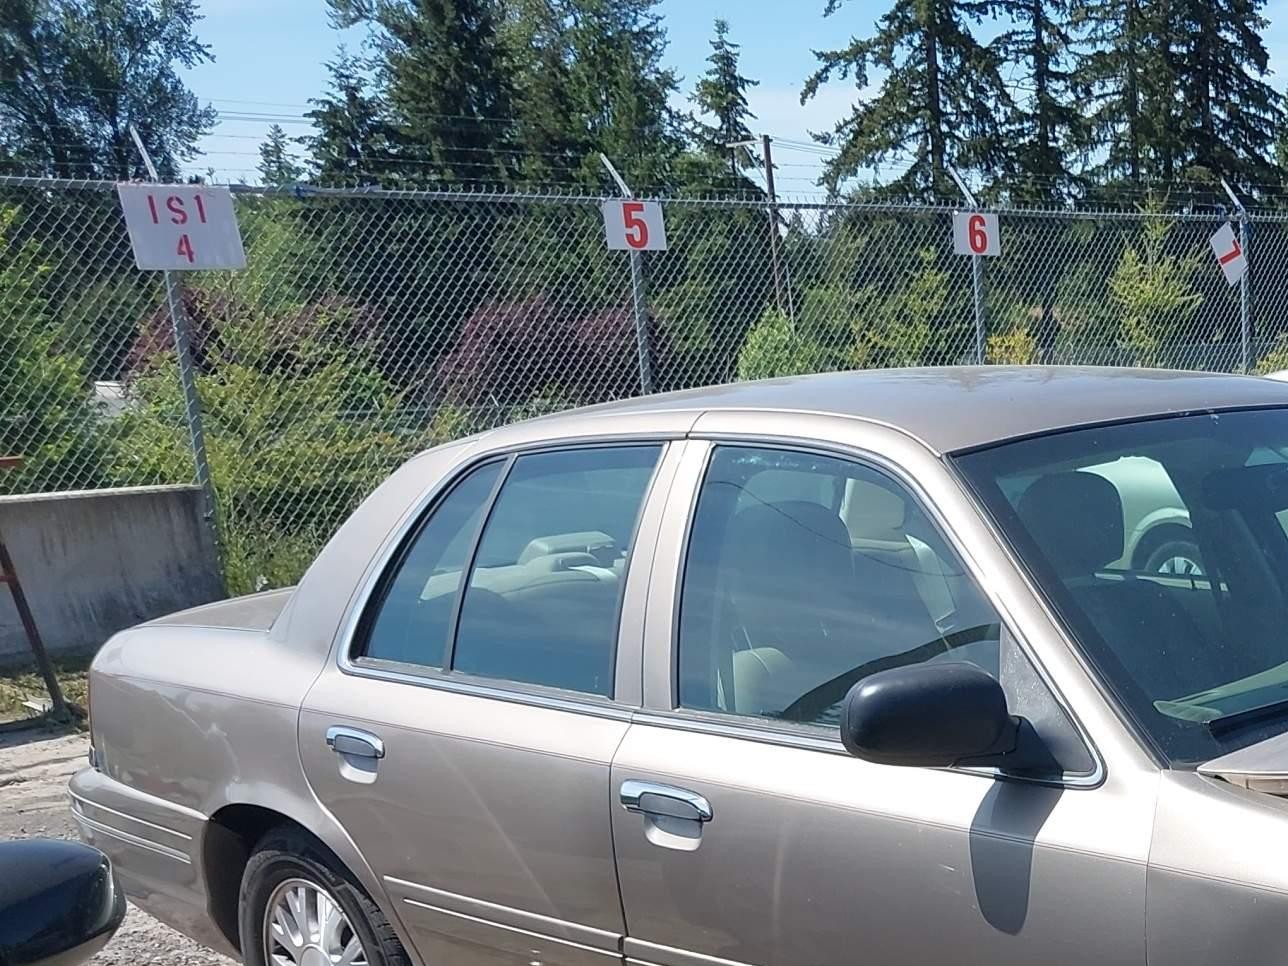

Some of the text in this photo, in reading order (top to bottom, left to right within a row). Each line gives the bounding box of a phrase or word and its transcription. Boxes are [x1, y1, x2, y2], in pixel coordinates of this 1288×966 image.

[622, 202, 649, 250] 5
[967, 214, 988, 255] 6
[176, 233, 195, 263] 4
